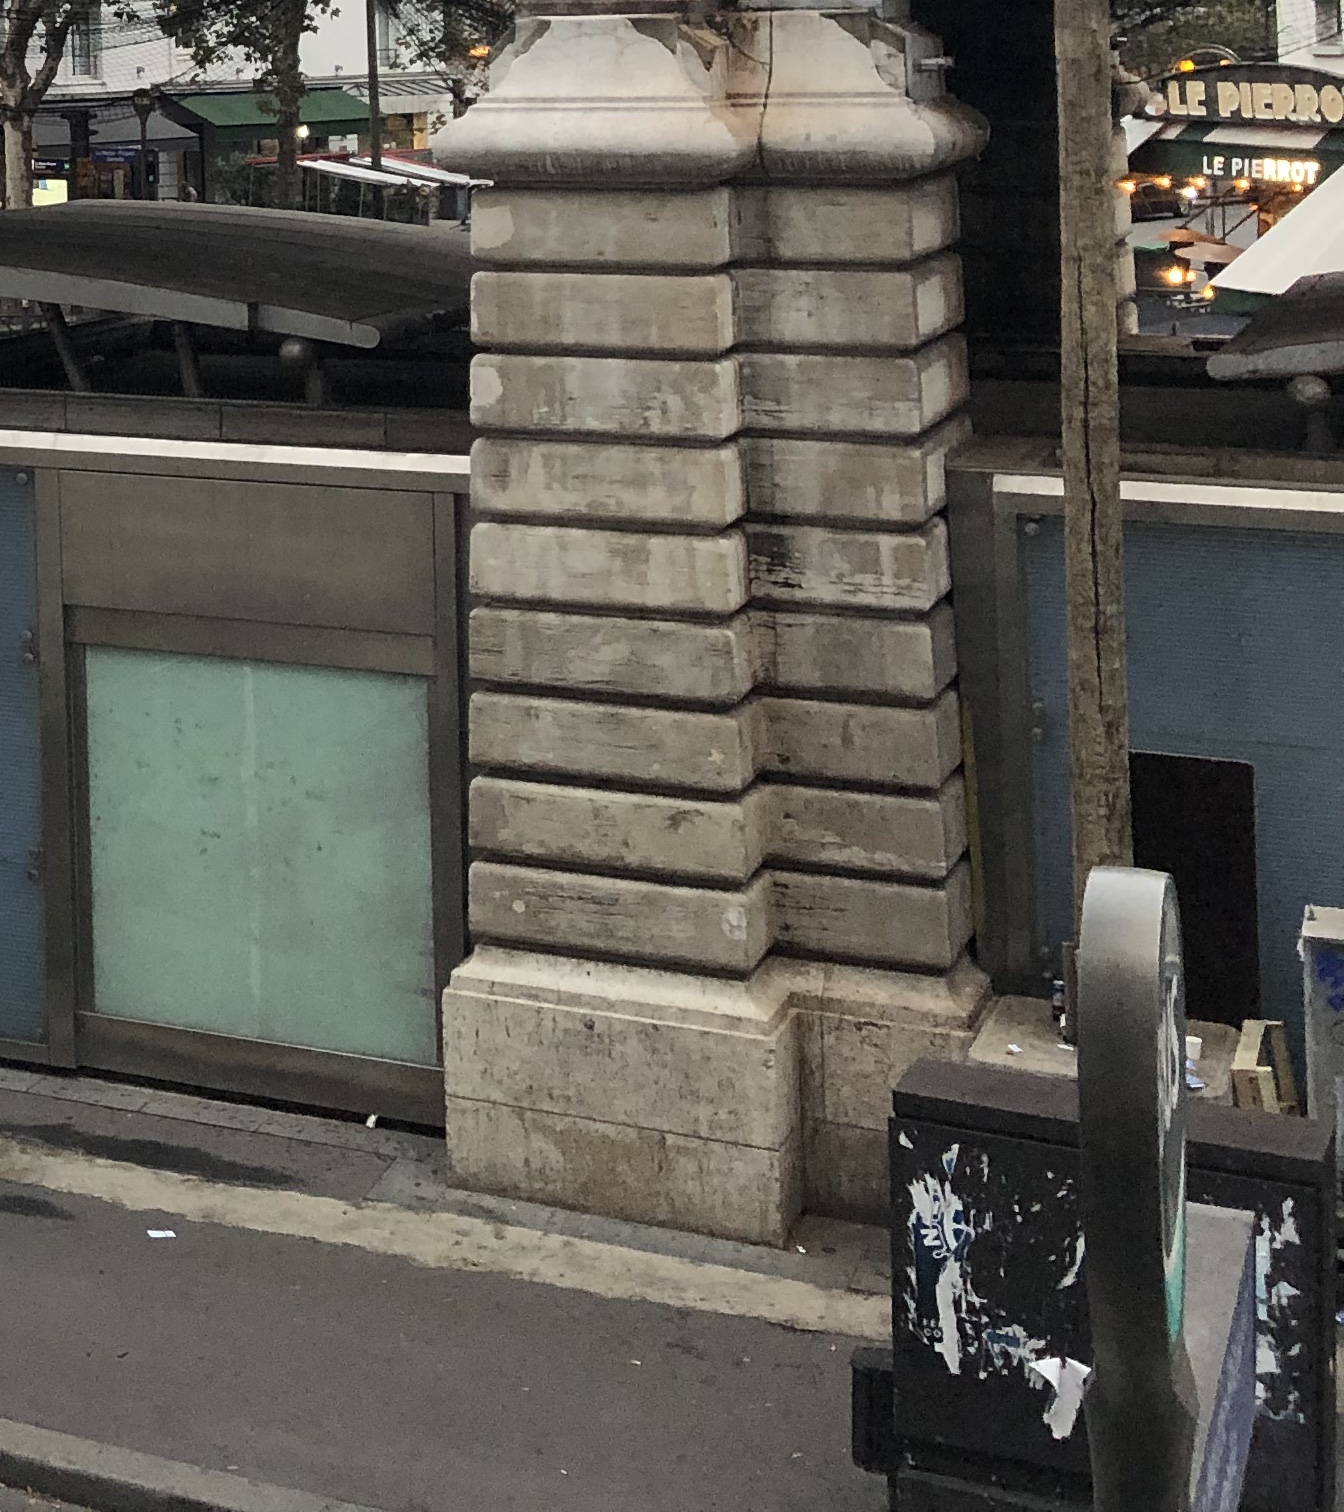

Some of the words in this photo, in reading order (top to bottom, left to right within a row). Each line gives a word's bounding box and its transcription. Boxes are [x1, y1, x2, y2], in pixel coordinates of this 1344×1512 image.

[1167, 80, 1207, 116] LE
[1216, 81, 1344, 123] PIERRO
[1202, 155, 1225, 176] LE
[1231, 157, 1320, 185] PIERROT
